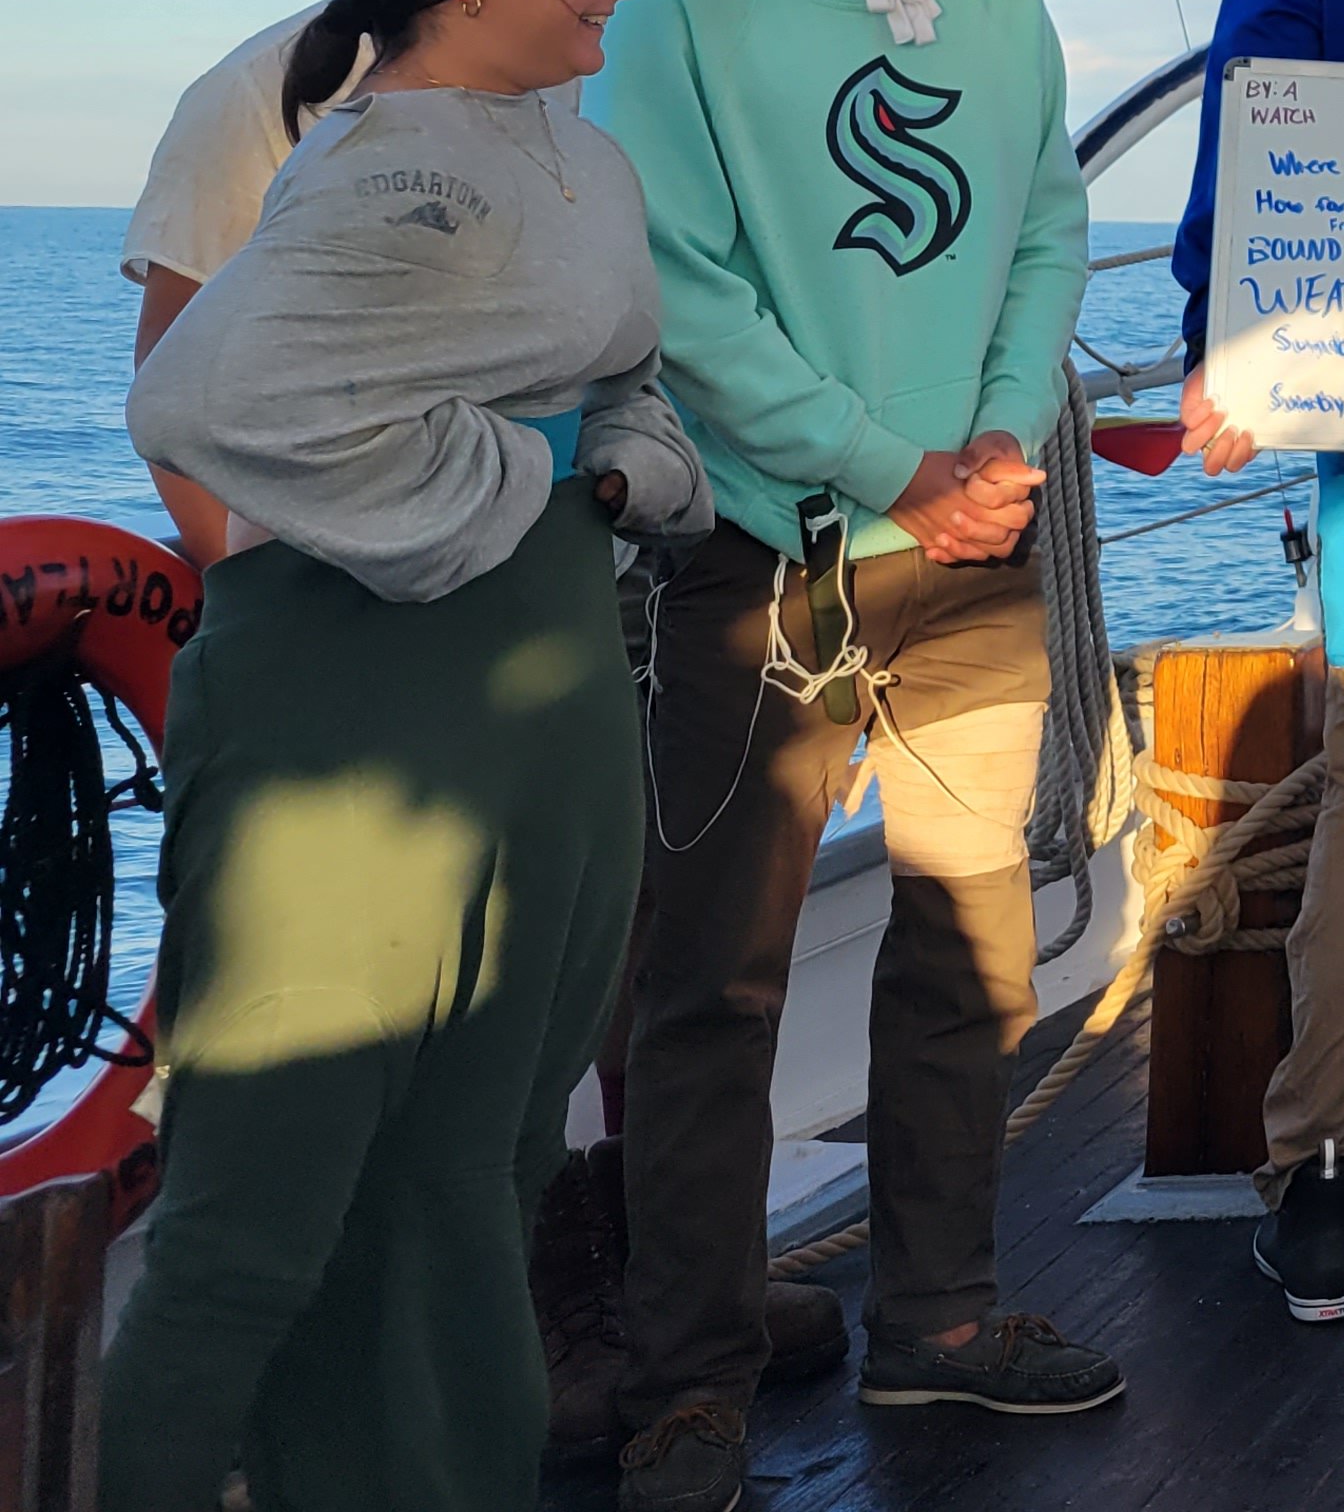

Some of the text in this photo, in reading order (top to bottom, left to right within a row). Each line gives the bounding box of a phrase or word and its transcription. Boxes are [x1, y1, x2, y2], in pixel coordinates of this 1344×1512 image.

[1246, 80, 1298, 101] BY: A
[1251, 106, 1316, 125] WATCH
[1268, 150, 1341, 176] Where
[355, 169, 492, 226] EDGARTOWN
[1256, 189, 1304, 215] How
[1248, 236, 1342, 266] BOUND
